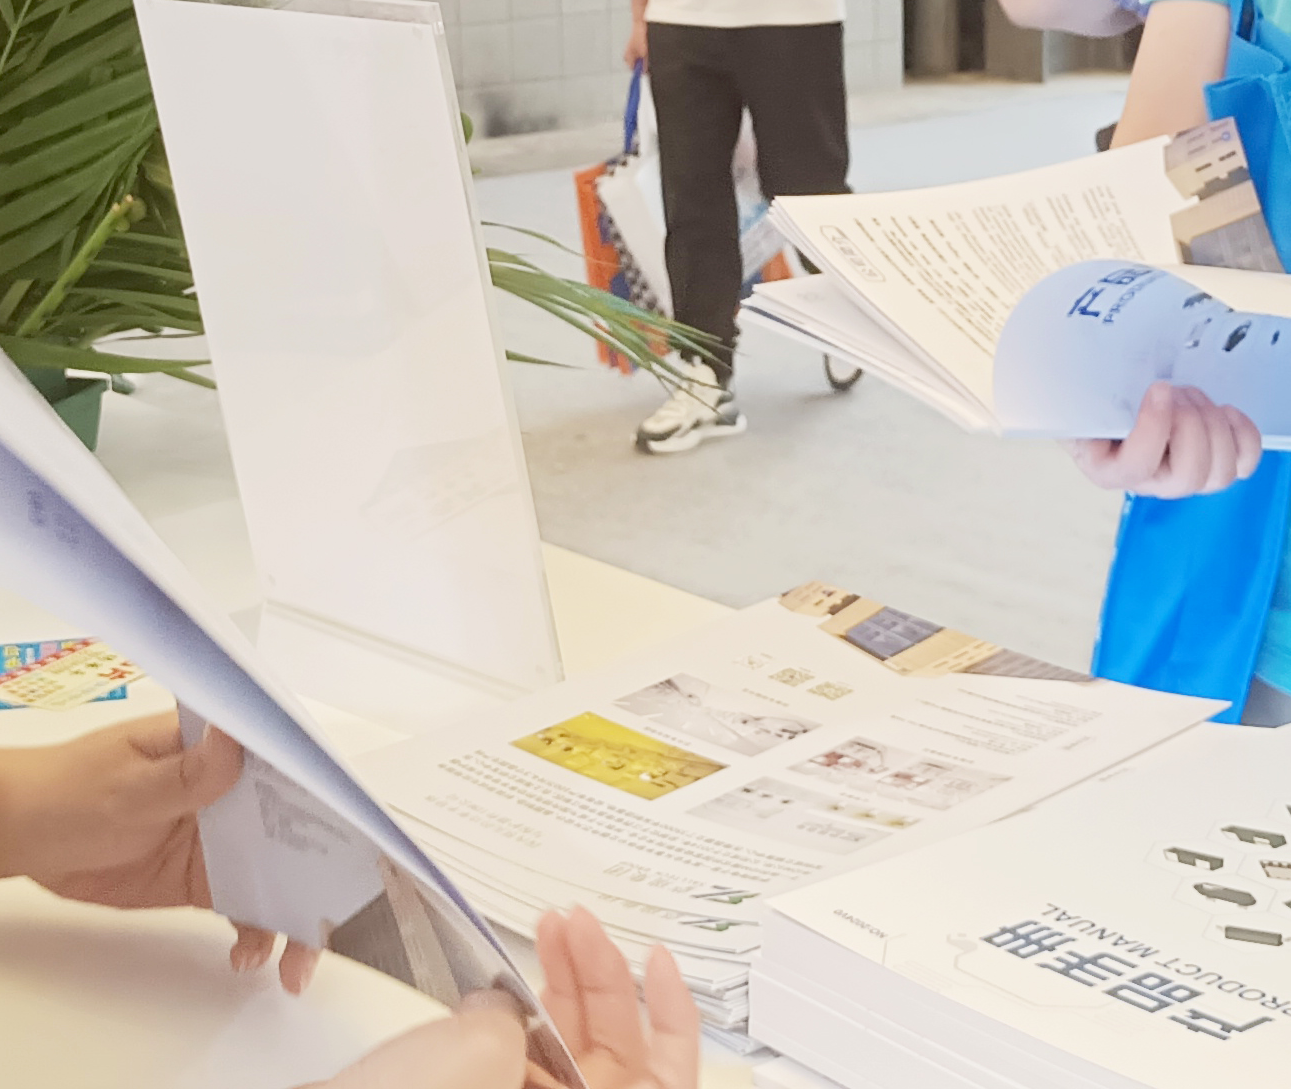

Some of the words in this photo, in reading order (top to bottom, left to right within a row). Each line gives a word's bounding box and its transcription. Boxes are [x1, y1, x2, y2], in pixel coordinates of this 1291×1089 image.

[1040, 902, 1161, 959] MANUAL
[978, 919, 1275, 1041] 产品手册
